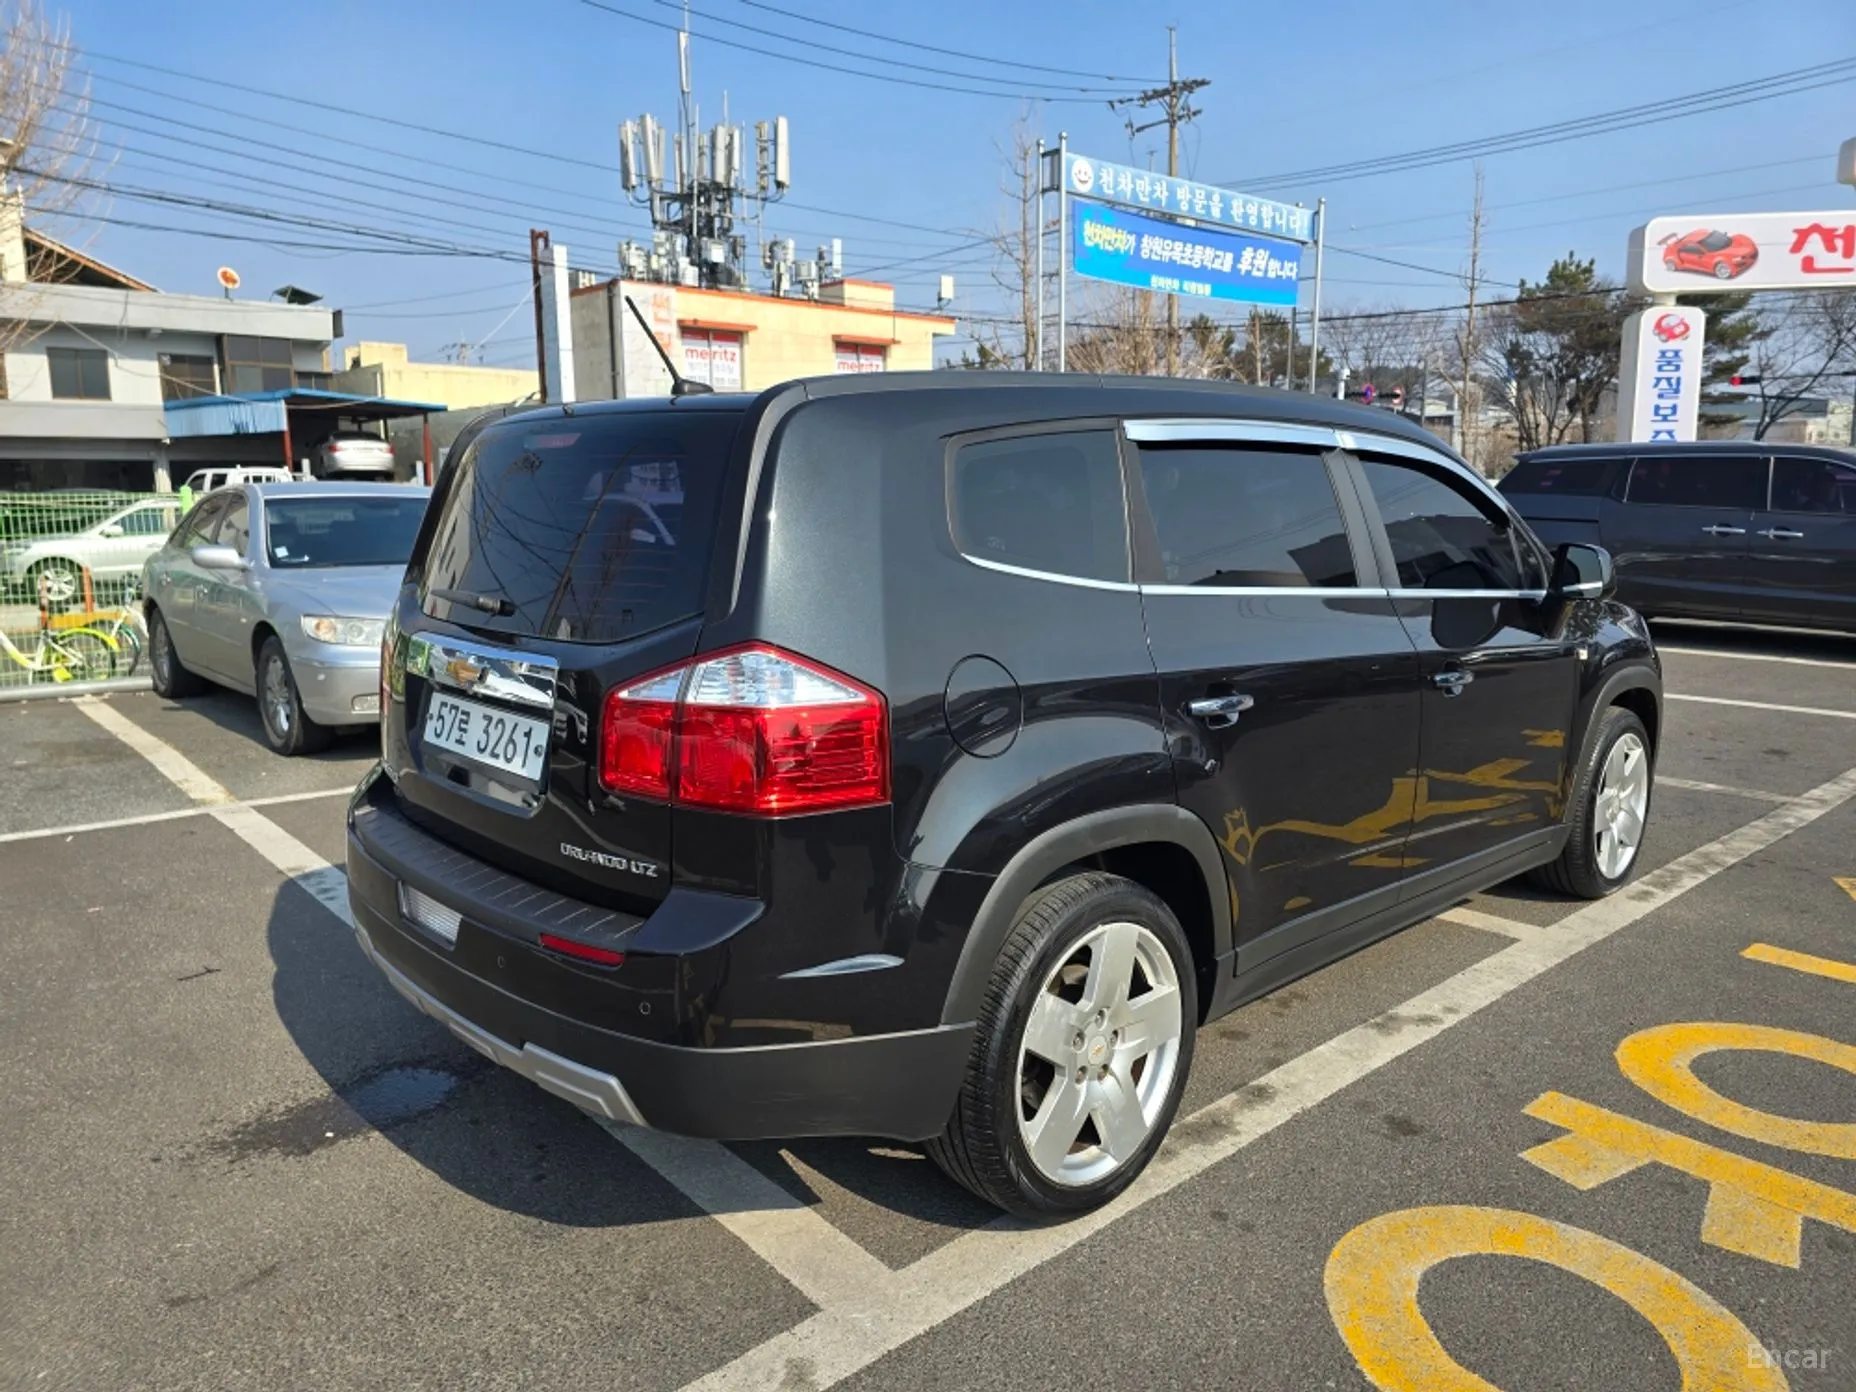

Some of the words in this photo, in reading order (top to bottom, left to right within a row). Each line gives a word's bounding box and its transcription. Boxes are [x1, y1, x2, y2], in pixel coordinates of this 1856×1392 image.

[1099, 166, 1169, 207] 천차만차
[1176, 185, 1223, 219] 방문을
[1789, 223, 1855, 273] 천
[685, 347, 737, 365] meritz
[434, 701, 471, 747] 57로
[476, 713, 533, 769] 3261
[560, 842, 628, 870] ORLANDO
[630, 860, 659, 878] LTZ
